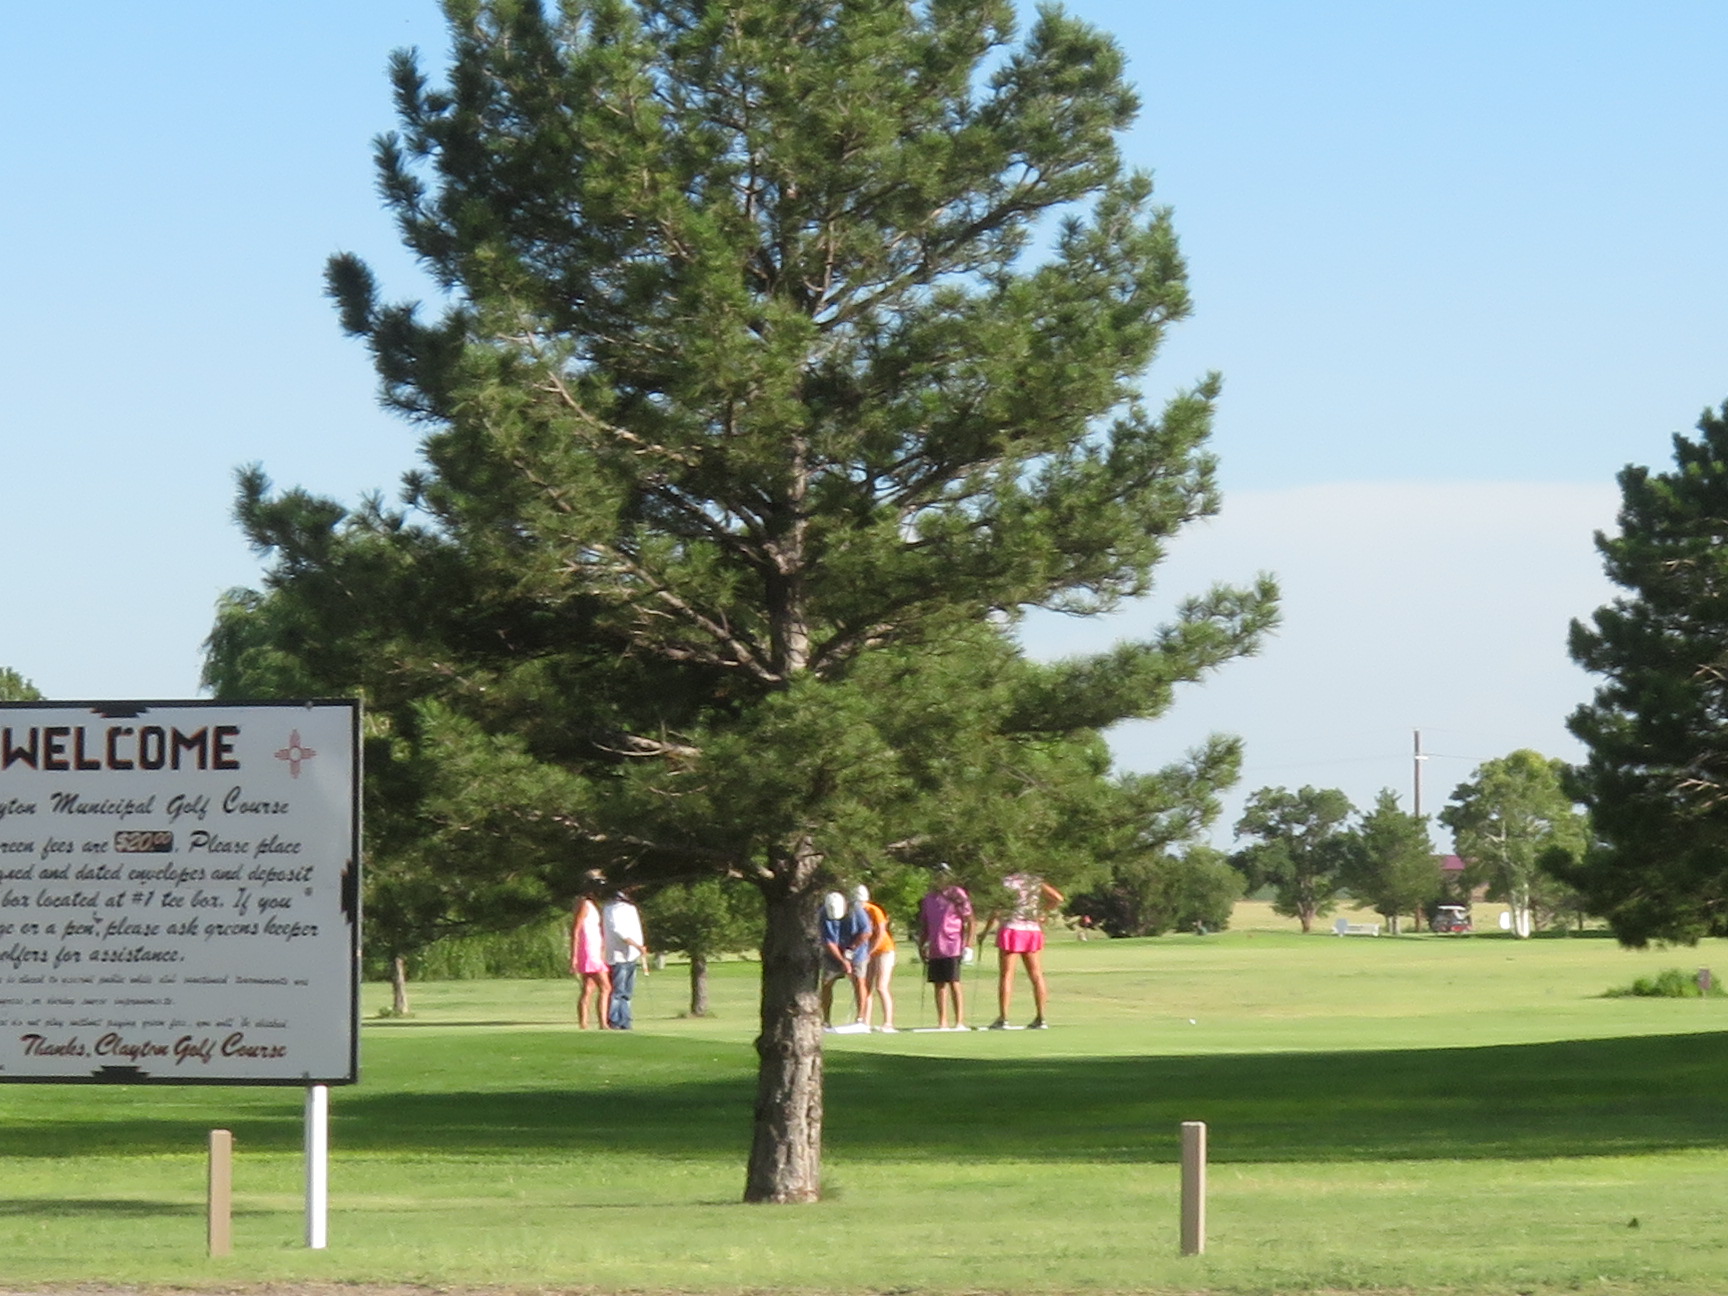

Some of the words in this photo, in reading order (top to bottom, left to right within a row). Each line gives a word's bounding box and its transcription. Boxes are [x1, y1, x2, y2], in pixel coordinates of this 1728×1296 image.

[1, 726, 240, 771] WELCOME
[50, 790, 156, 820] Municipal
[167, 793, 211, 823] Golf
[223, 785, 290, 815] Course
[41, 837, 74, 860] fees
[82, 841, 109, 853] are
[188, 830, 250, 853] Please
[254, 834, 302, 859] place
[39, 863, 71, 880] and
[75, 863, 122, 880] dated
[128, 861, 206, 888] envelopes
[210, 863, 244, 880] and
[248, 864, 314, 887] deposit
[1, 888, 31, 908] box
[36, 888, 100, 908] located
[104, 891, 126, 908] at
[132, 890, 155, 907] #1
[161, 892, 185, 908] tee
[190, 889, 224, 908] box.
[232, 887, 252, 916] If
[257, 896, 292, 914] you
[20, 922, 38, 935] or
[45, 923, 56, 935] a
[102, 916, 160, 941] please
[166, 916, 198, 936] ask
[204, 922, 260, 942] greens
[263, 915, 319, 942] keeper
[53, 946, 81, 969] for
[89, 945, 185, 963] assistance.
[94, 1032, 169, 1061] Clayton
[173, 1035, 217, 1065] Golf
[221, 1032, 287, 1059] Course
